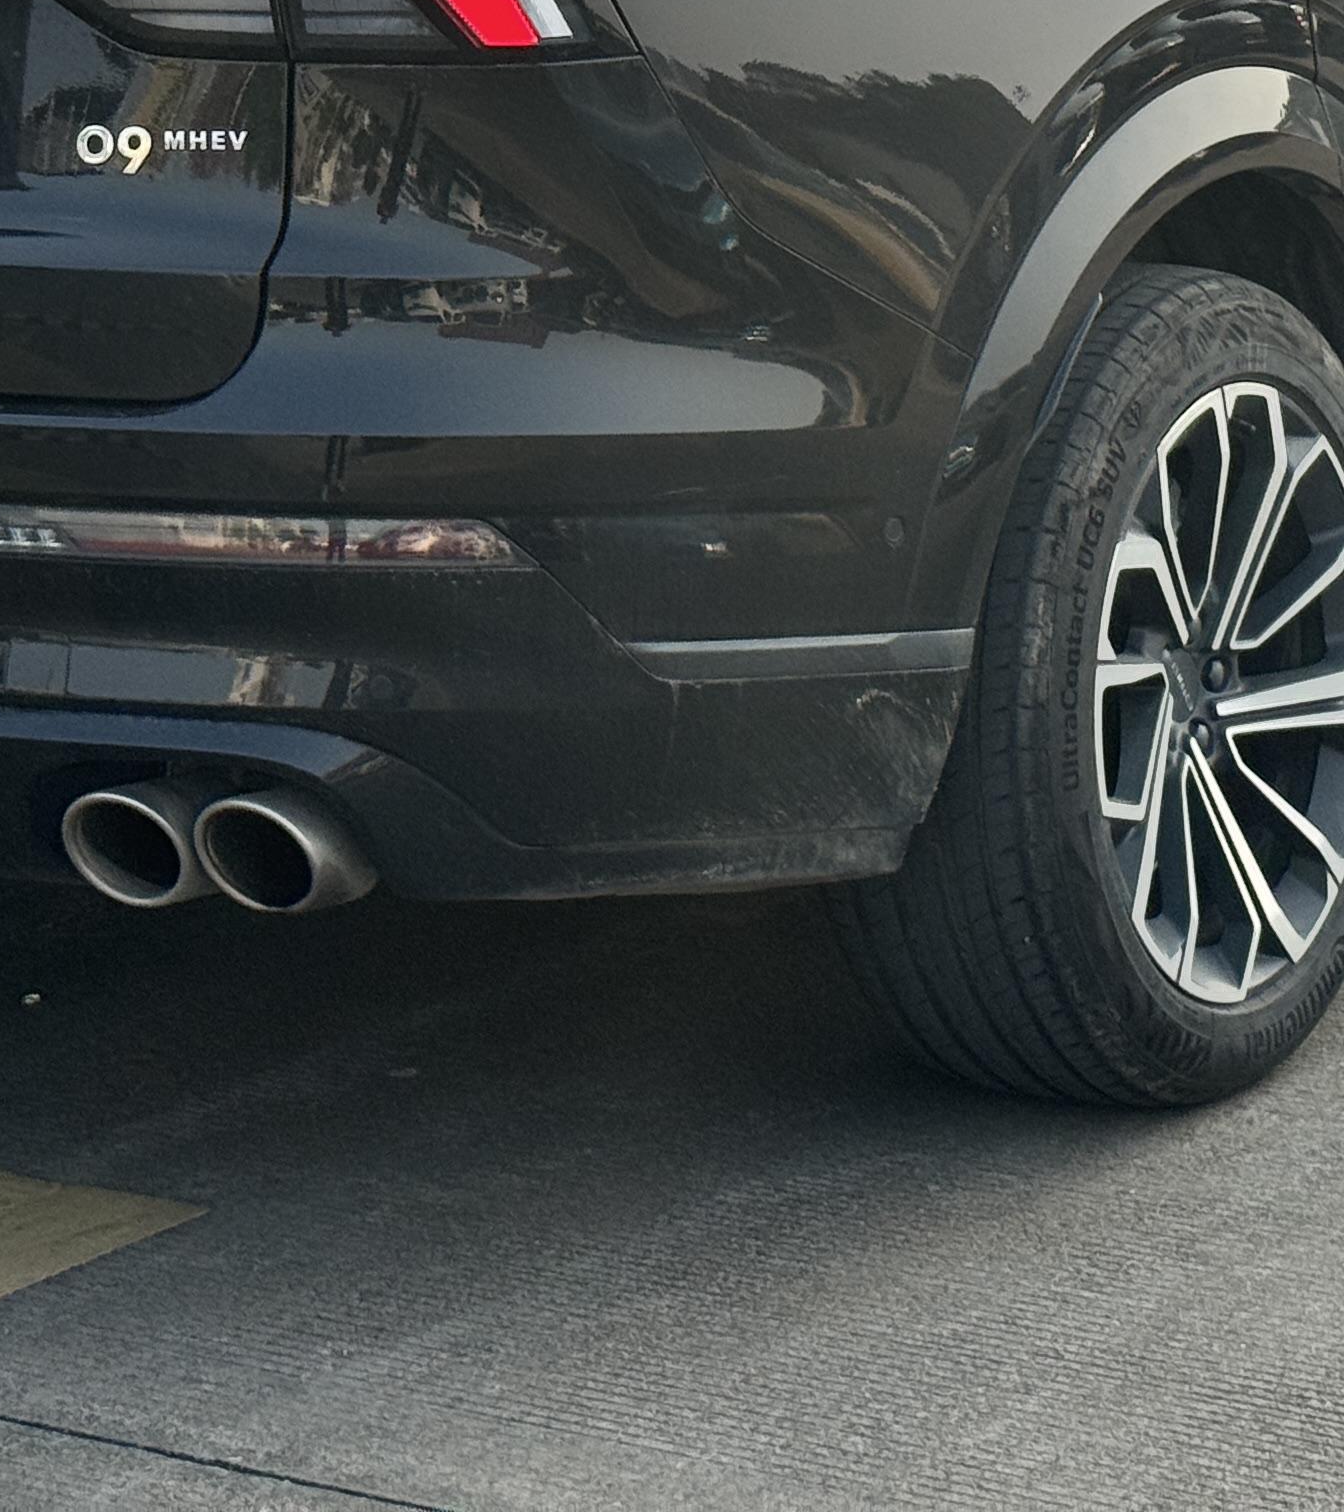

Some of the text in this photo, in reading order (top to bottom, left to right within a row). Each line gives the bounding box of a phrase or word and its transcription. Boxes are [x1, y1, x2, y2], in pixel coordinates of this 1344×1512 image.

[76, 124, 249, 175] 09 MHEV
[1076, 503, 1106, 571] UC6
